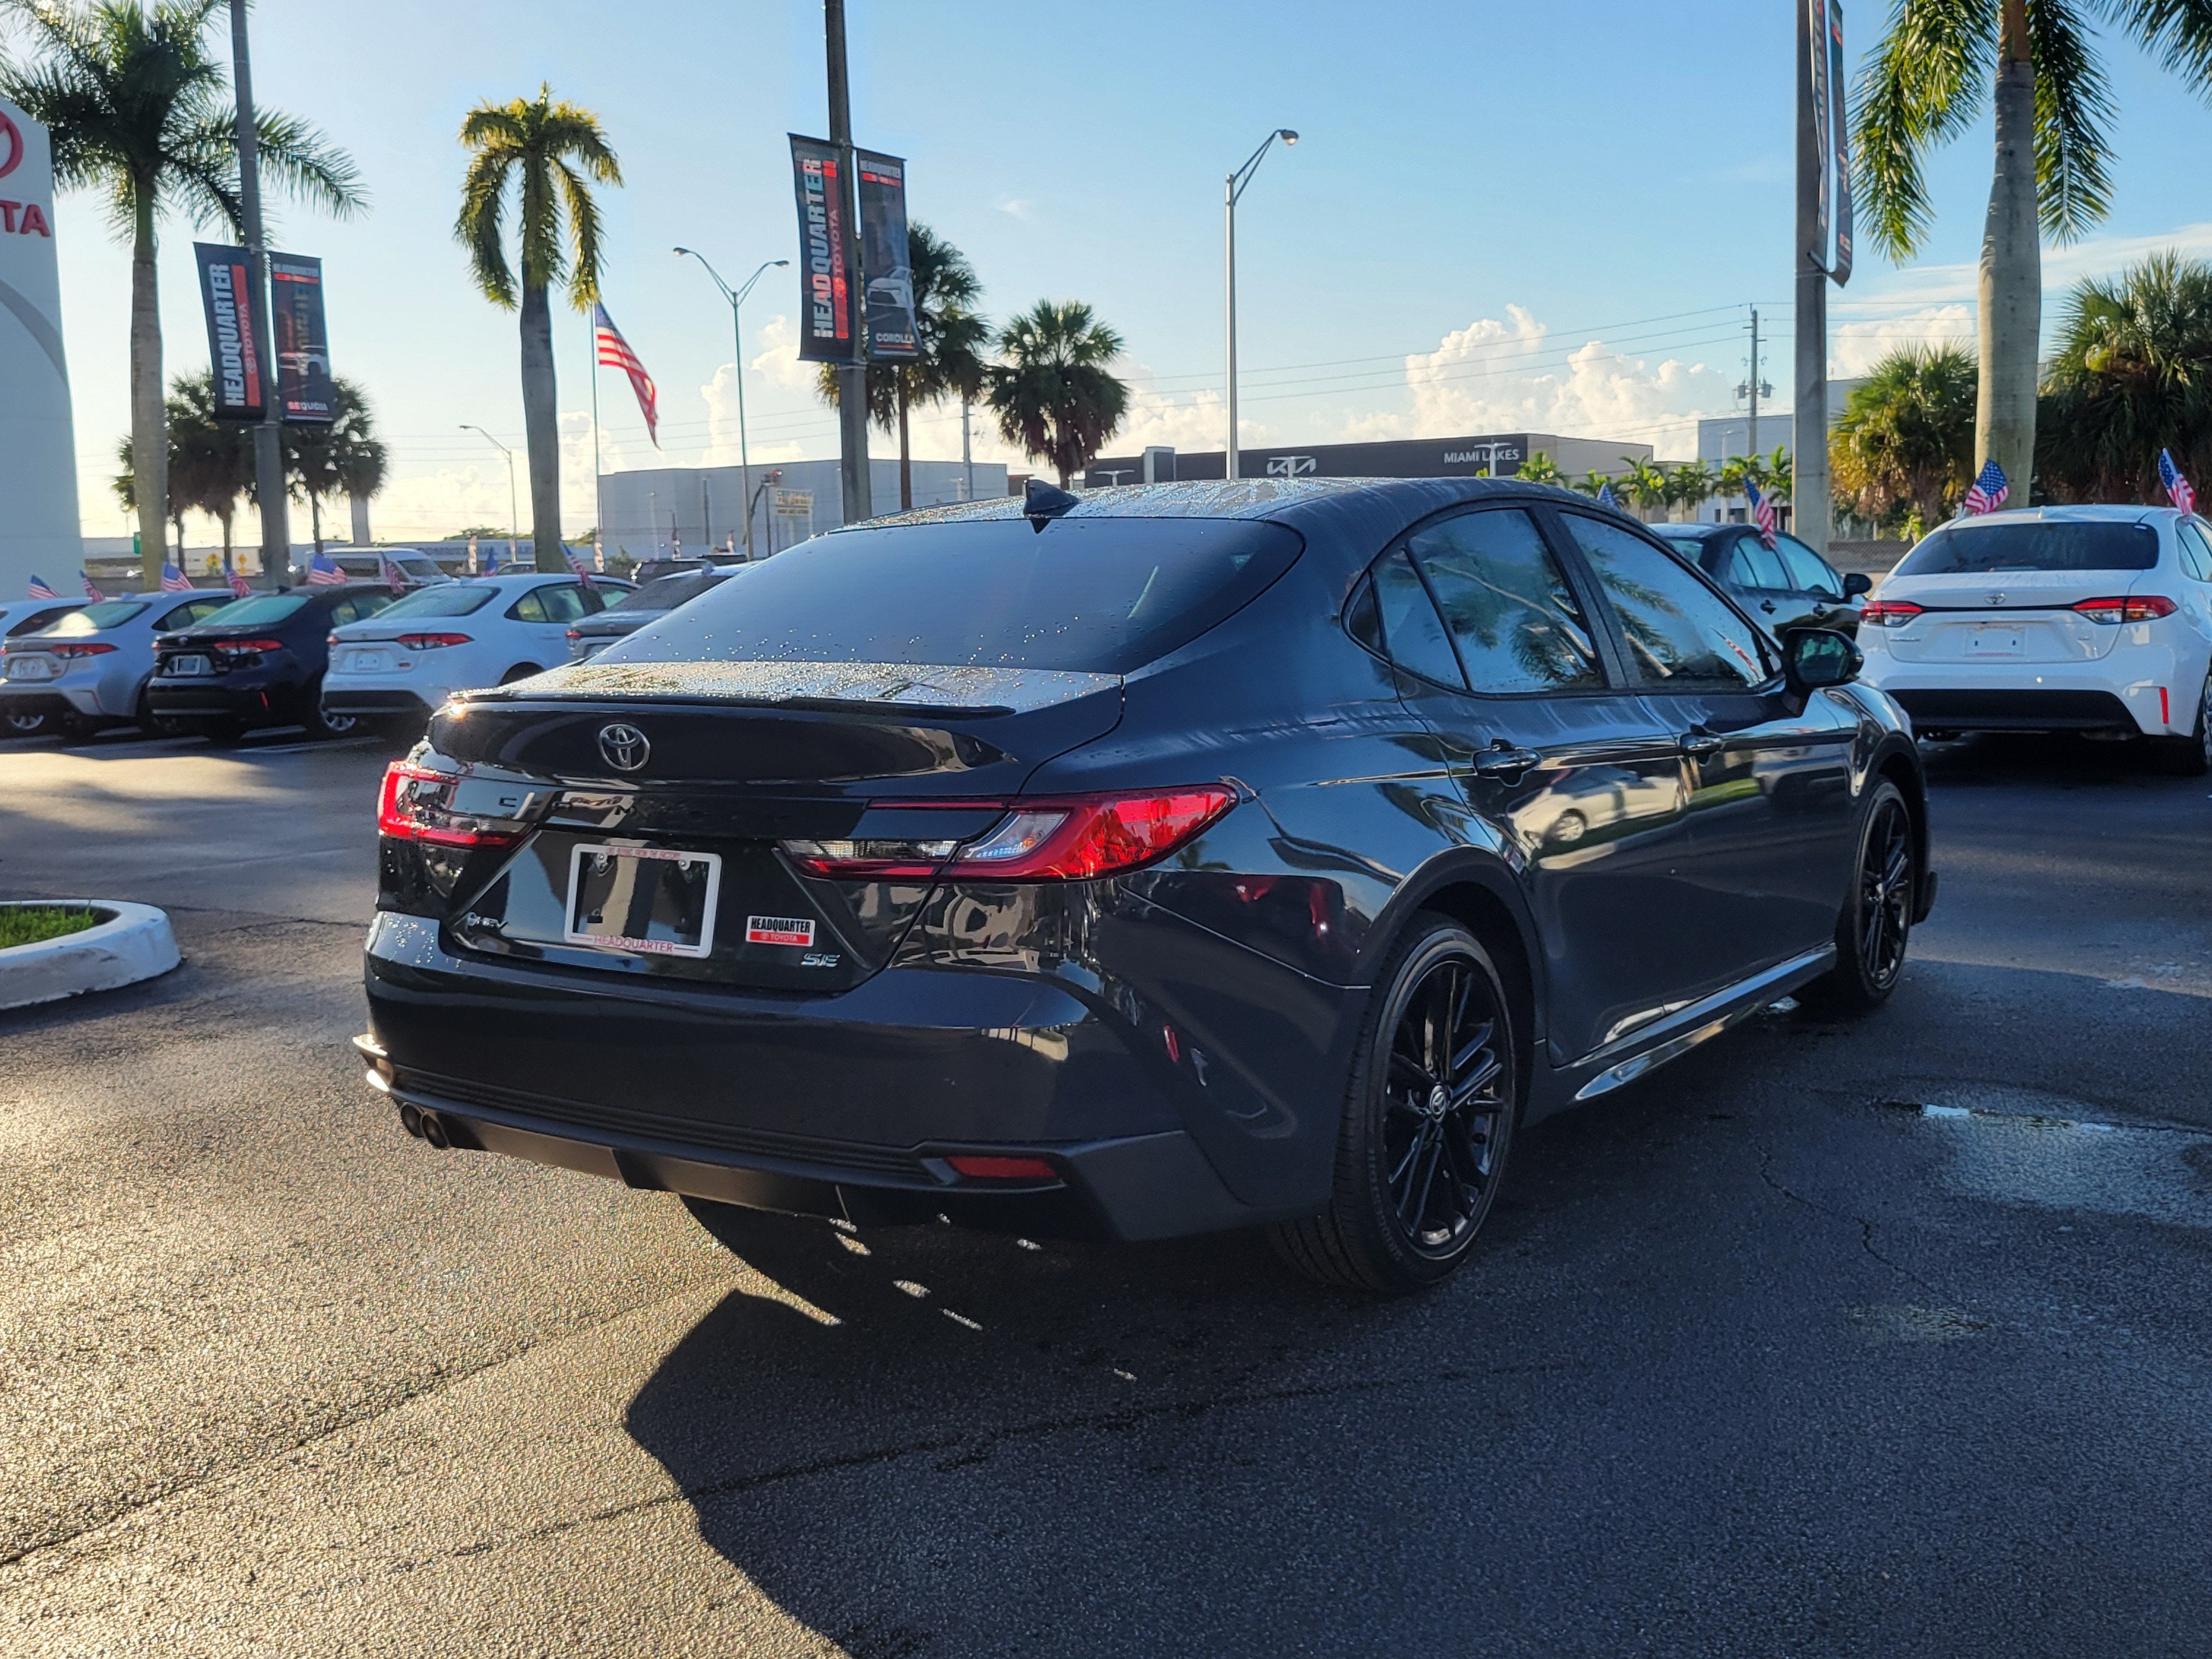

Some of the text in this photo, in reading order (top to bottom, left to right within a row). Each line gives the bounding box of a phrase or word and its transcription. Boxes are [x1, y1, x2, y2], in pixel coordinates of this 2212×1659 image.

[803, 159, 833, 338] HEADQUARTER
[828, 210, 842, 274] TOYOTA
[208, 263, 245, 407] HEADQUARTER
[238, 303, 252, 356] TOYOTA
[1443, 449, 1519, 464] MIAMI LKES
[751, 917, 811, 933] HEADQUARTER
[594, 935, 673, 952] HEADQUARTER
[771, 933, 798, 942] TOYOTA
[800, 952, 840, 968] SE
